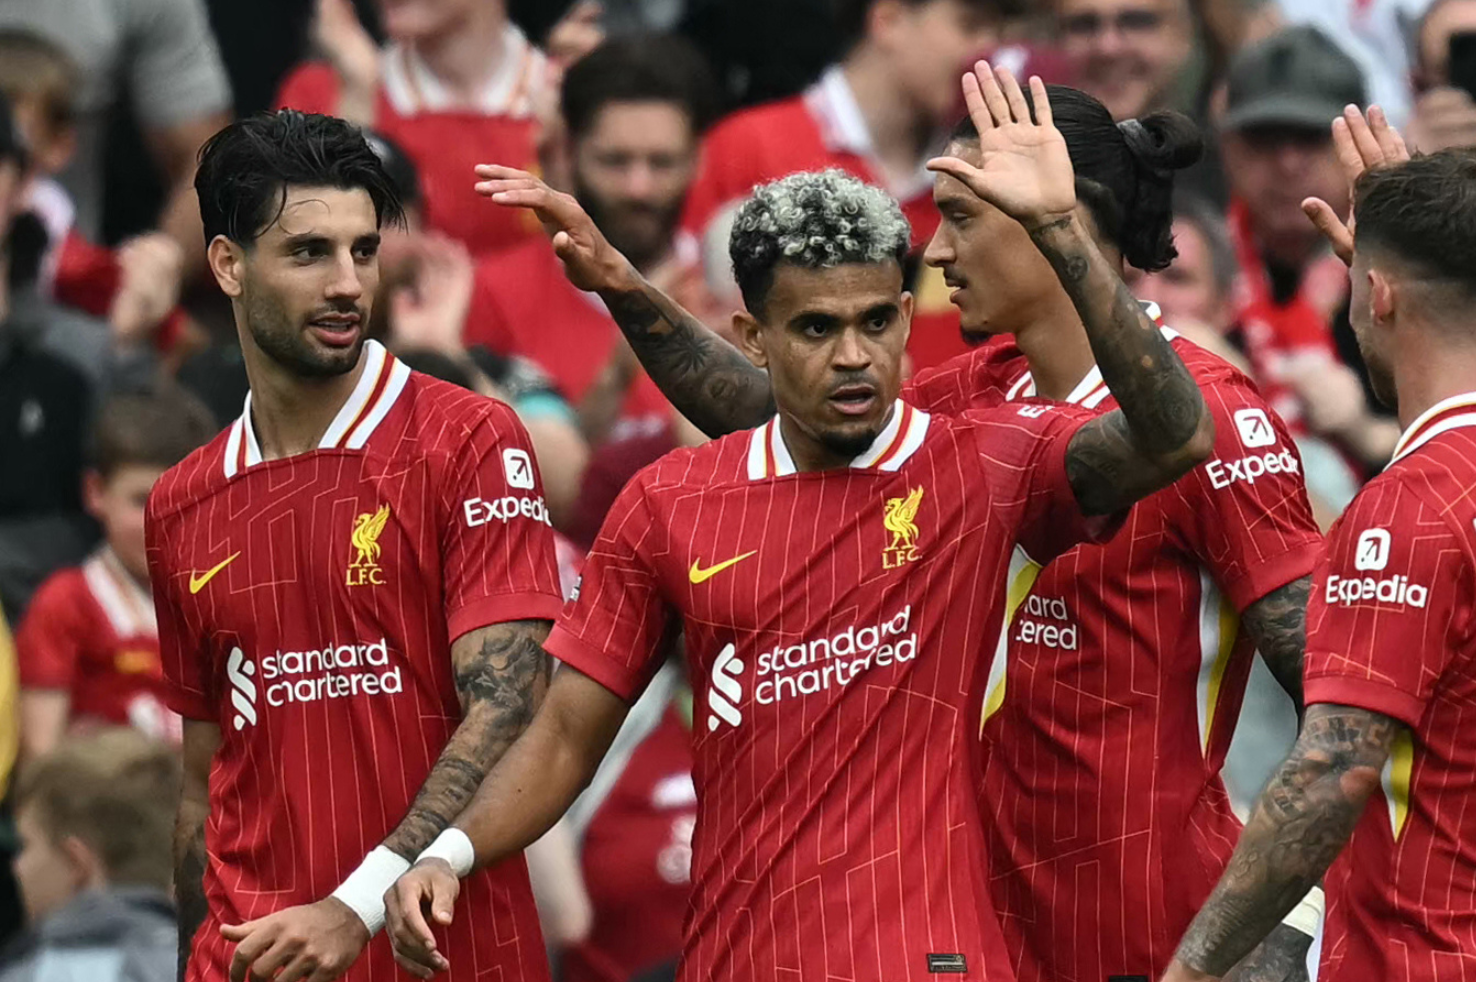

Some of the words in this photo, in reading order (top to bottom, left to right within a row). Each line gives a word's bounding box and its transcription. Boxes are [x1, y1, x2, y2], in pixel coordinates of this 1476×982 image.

[1205, 448, 1300, 489] Expedi
[345, 567, 387, 586] L.F.C.
[1325, 574, 1428, 608] Expedia
[262, 637, 390, 679] standard
[757, 604, 912, 675] standard
[266, 666, 403, 706] chartered
[755, 633, 918, 704] chartered
